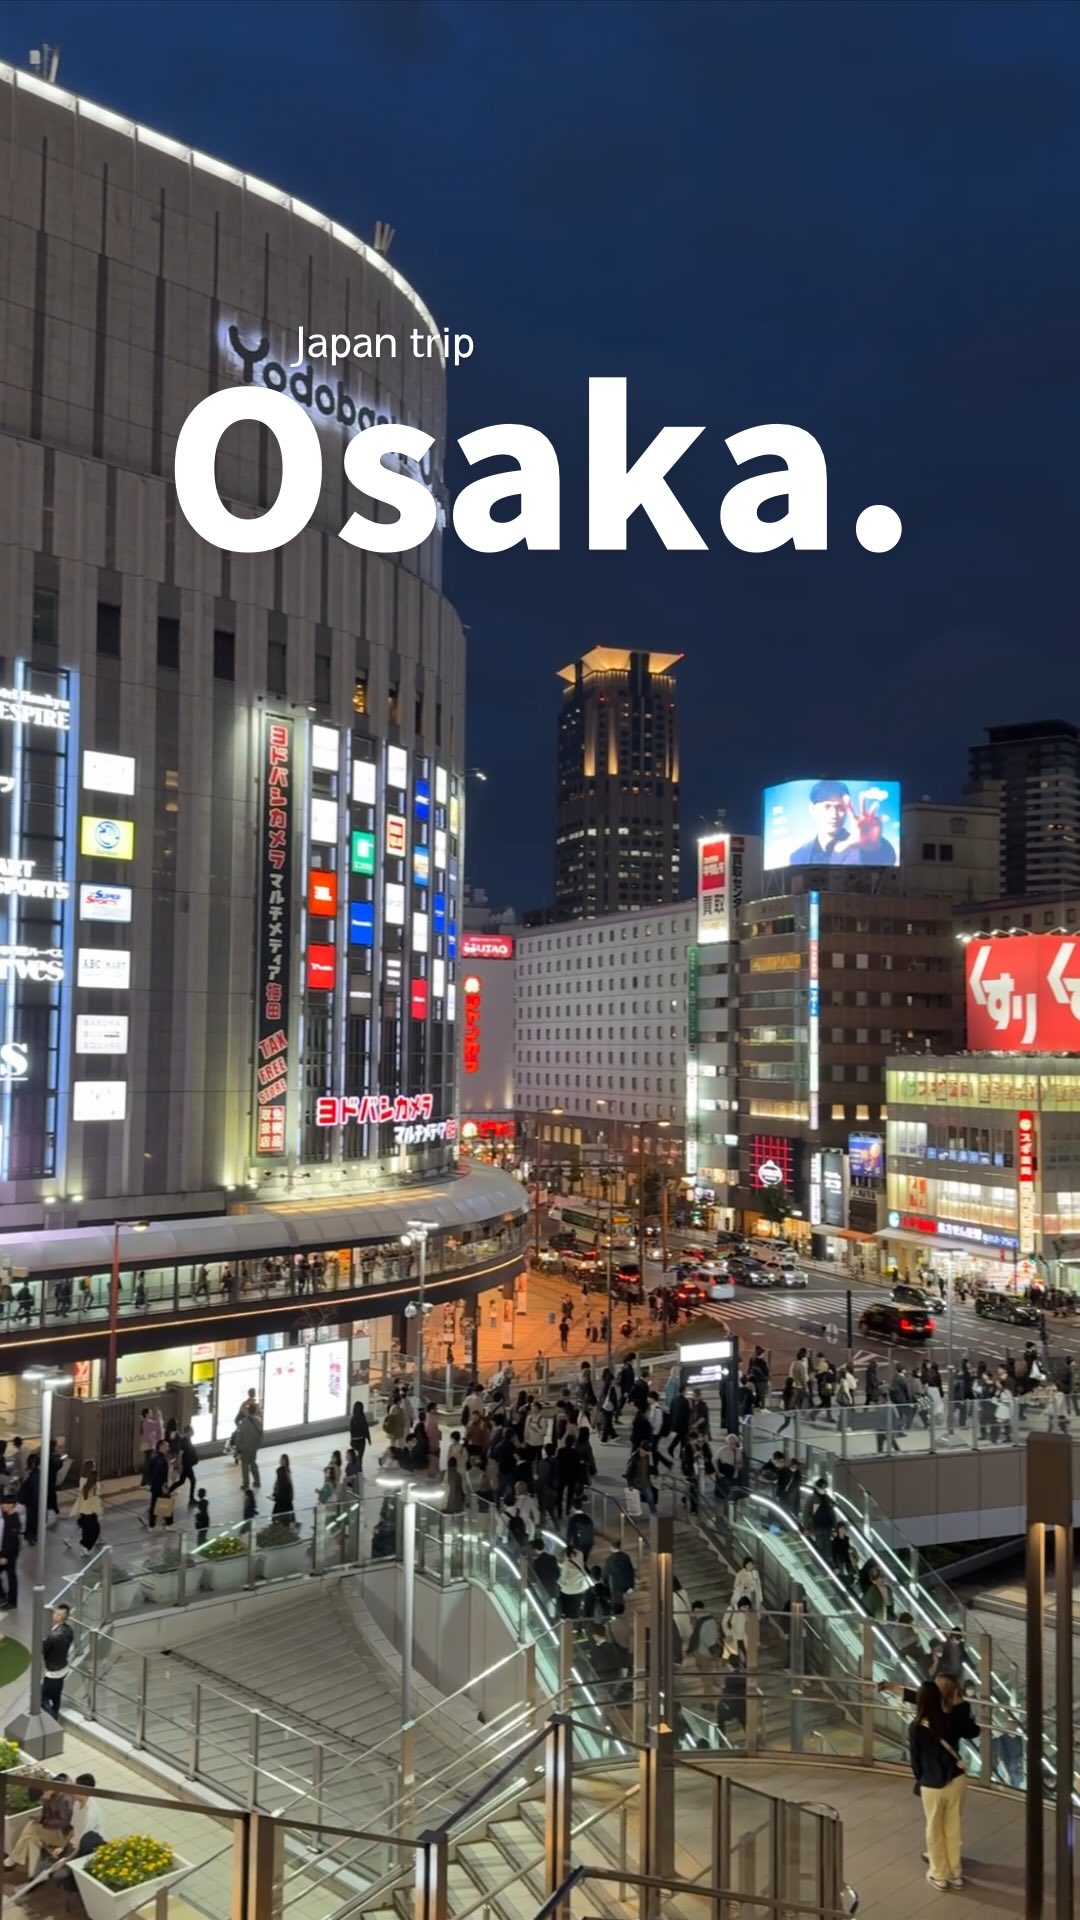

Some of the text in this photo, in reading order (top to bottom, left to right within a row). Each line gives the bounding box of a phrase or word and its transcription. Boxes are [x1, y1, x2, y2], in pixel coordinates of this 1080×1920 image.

[969, 945, 1037, 1044] くすり
[258, 1030, 288, 1060] TAX
[257, 1056, 288, 1085] FREE
[257, 1078, 288, 1105] STORE
[316, 1094, 433, 1126] ヨドバシカメラ
